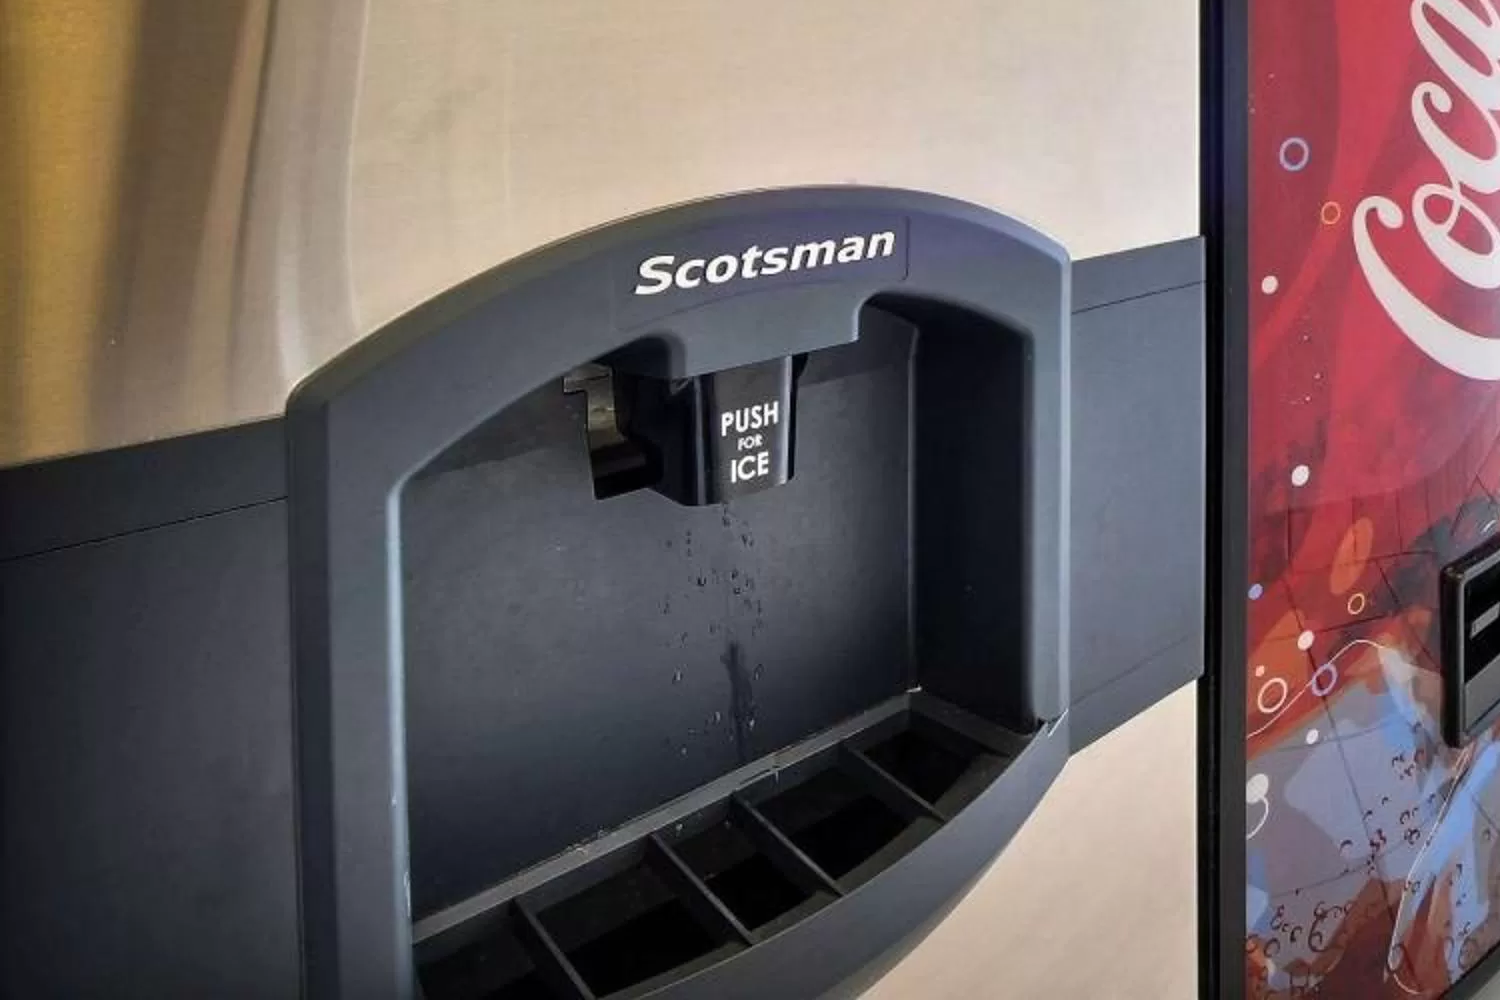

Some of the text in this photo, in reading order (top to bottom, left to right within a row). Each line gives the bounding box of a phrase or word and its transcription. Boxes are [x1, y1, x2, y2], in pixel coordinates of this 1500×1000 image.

[634, 229, 896, 296] Scotsman
[720, 400, 780, 437] PUSH
[737, 433, 764, 451] FOR
[730, 451, 770, 483] ICE
